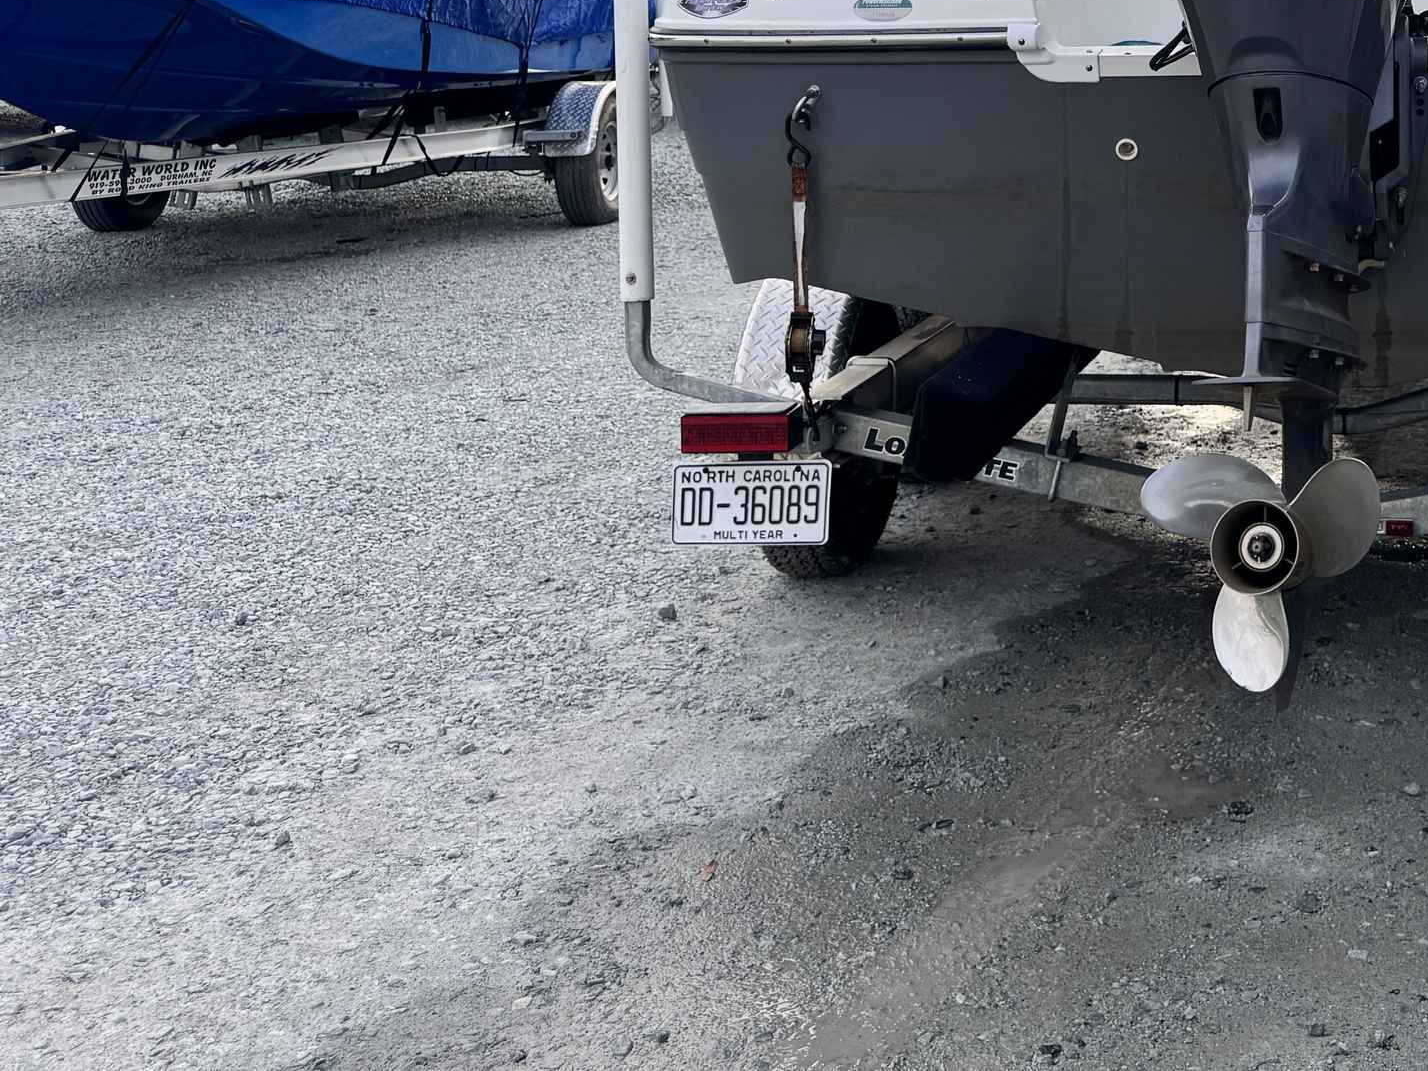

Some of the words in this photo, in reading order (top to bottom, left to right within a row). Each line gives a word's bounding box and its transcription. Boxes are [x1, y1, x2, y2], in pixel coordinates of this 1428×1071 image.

[87, 167, 137, 182] WATR
[142, 162, 190, 177] WORLD
[194, 159, 217, 170] INC
[108, 185, 136, 193] ROD
[681, 470, 736, 484] NORTH
[743, 468, 821, 483] CAROLINA
[680, 484, 821, 527] DD-36089
[713, 531, 748, 540] MULTI
[752, 529, 784, 540] YEAR
